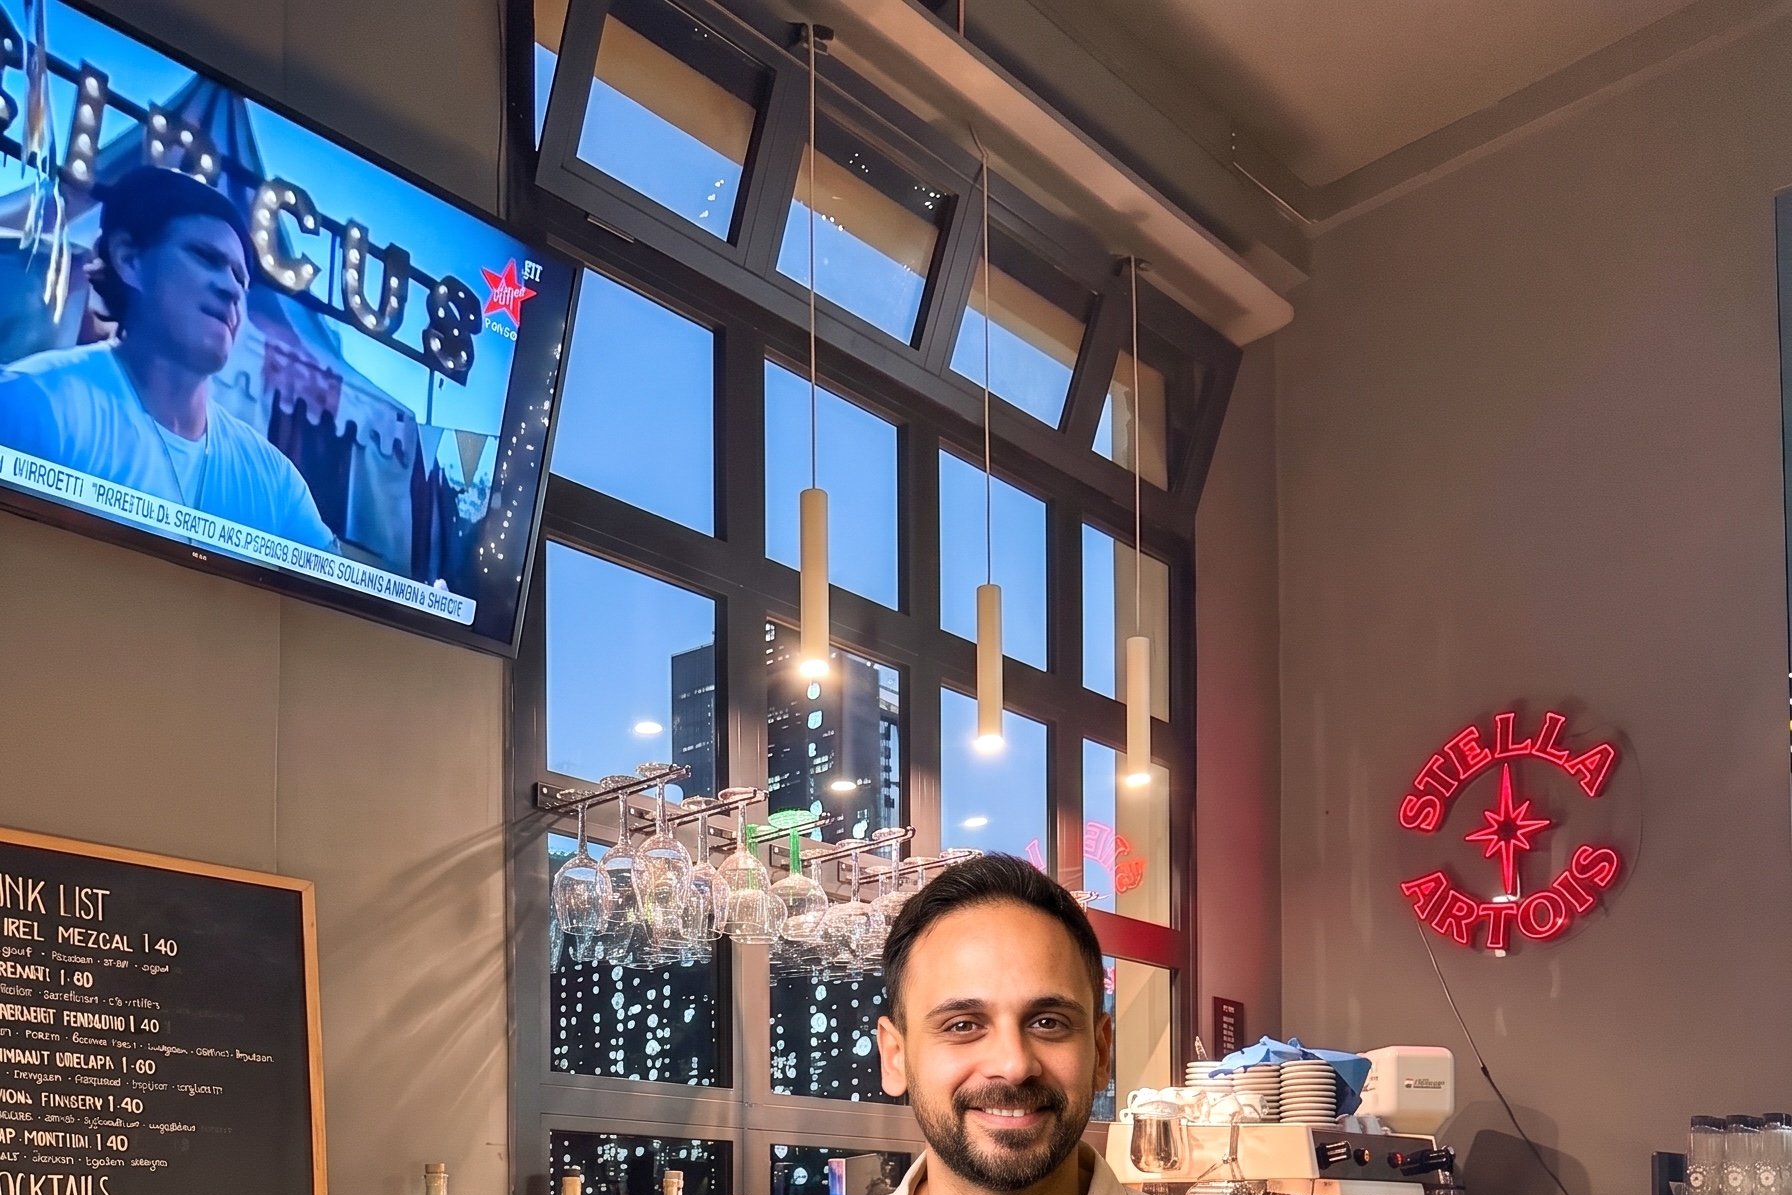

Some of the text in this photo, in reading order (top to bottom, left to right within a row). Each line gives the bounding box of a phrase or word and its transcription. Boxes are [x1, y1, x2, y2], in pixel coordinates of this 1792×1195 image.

[1399, 711, 1616, 832] STELLA
[59, 884, 111, 921] LIST
[1400, 844, 1619, 945] ARTOIS
[58, 925, 134, 953] MEZCAL
